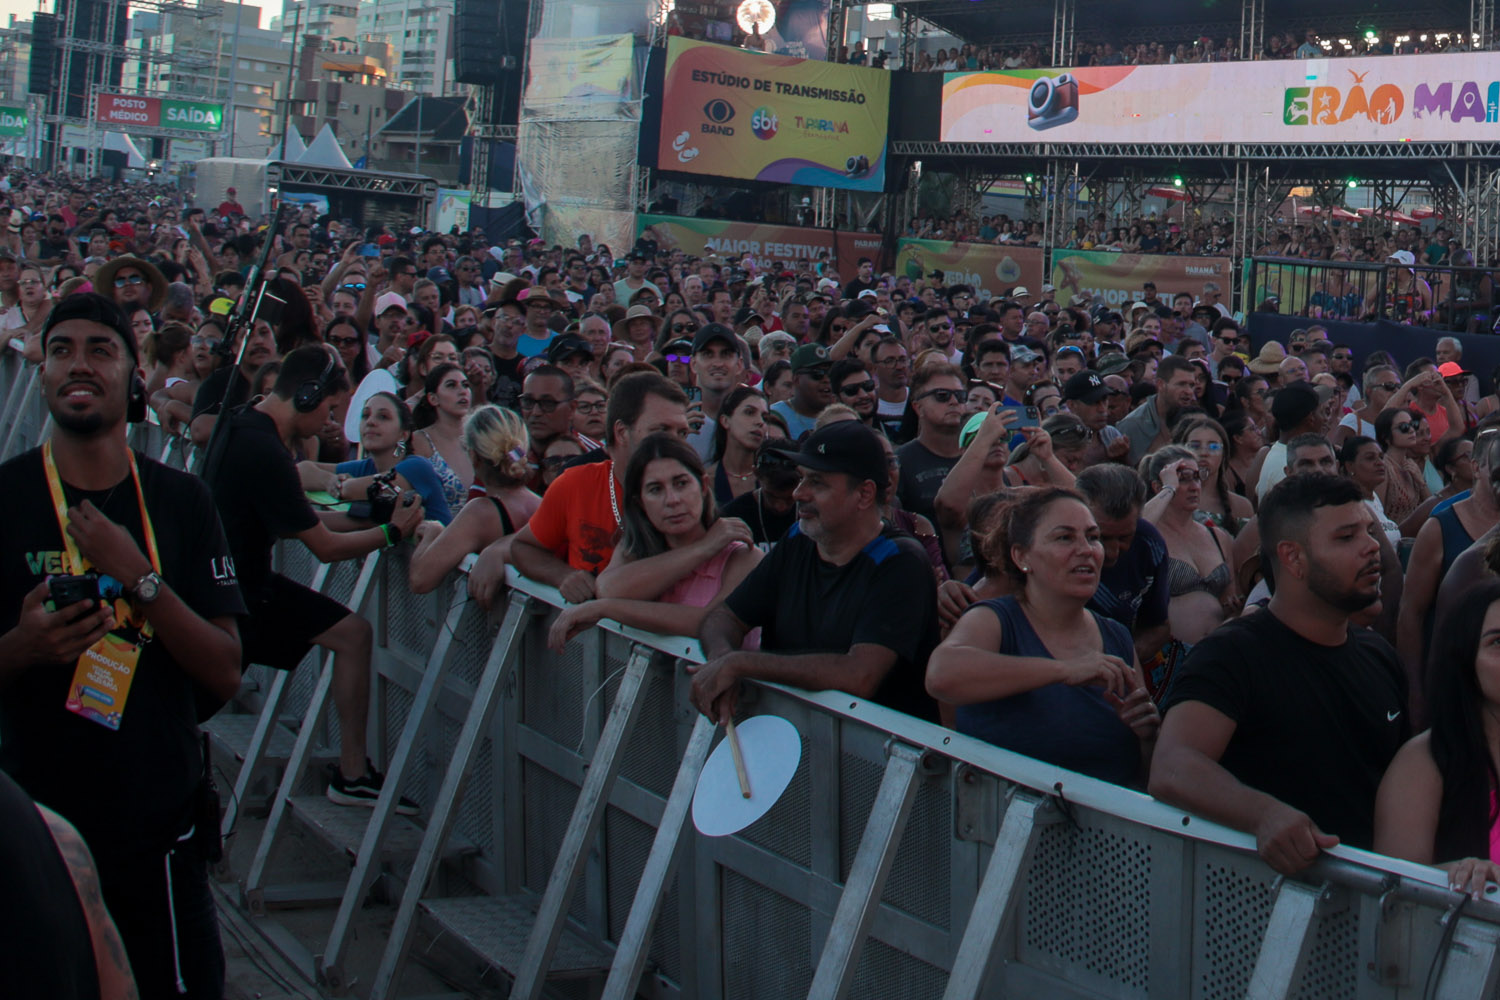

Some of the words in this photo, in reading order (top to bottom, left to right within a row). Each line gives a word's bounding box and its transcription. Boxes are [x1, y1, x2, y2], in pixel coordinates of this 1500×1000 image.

[691, 69, 750, 89] ESTÚDIO
[753, 79, 771, 92] DE
[775, 81, 866, 105] TRANSMISSÃO
[113, 98, 147, 109] POSTO
[109, 109, 149, 122] MÉDICO
[167, 106, 217, 125] SAÍDA
[752, 109, 778, 131] sbt
[701, 123, 735, 137] BAND
[707, 237, 760, 255] MAIOR
[854, 238, 882, 249] PARAN
[86, 649, 131, 675] PRODUÇÃO
